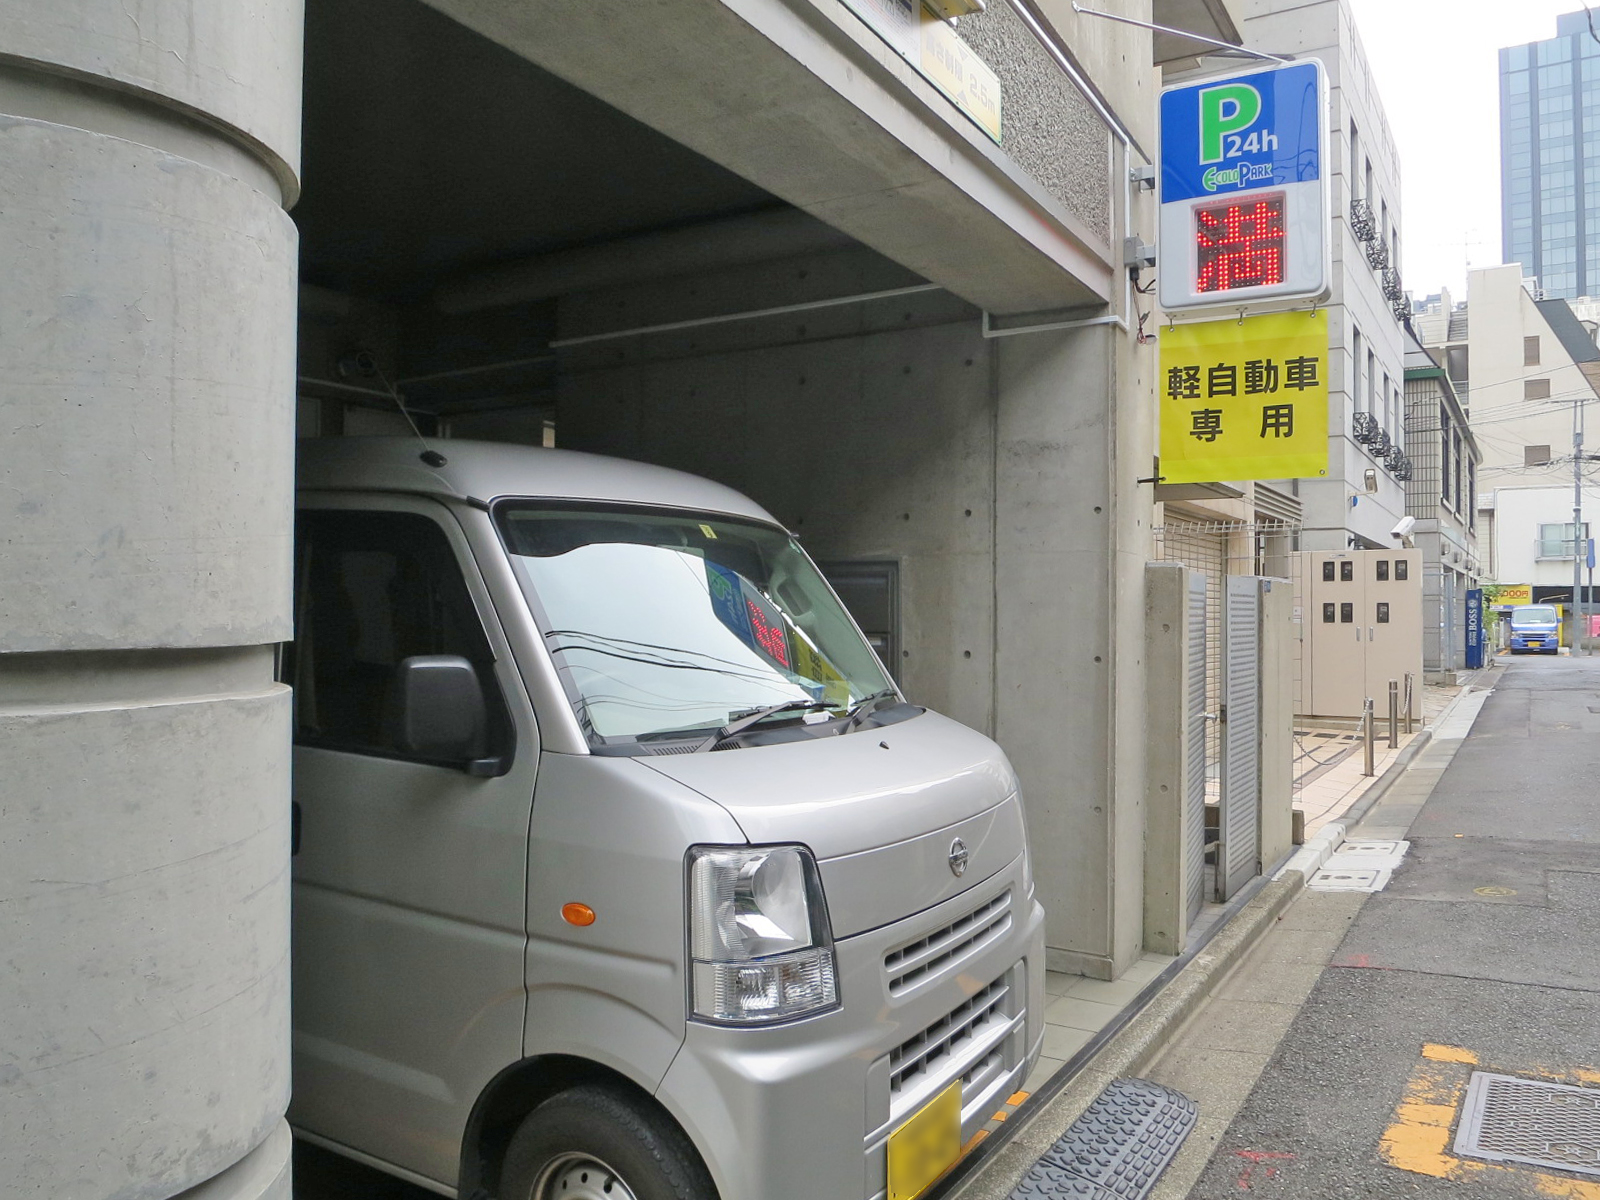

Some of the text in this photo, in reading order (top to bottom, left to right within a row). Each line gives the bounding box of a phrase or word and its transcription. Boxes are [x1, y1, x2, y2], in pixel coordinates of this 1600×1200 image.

[969, 73, 996, 116] 2.5m
[1199, 83, 1279, 165] P 24h
[1197, 201, 1284, 293] 満
[1167, 356, 1320, 400] 軽自動車
[1468, 608, 1477, 630] BOSS
